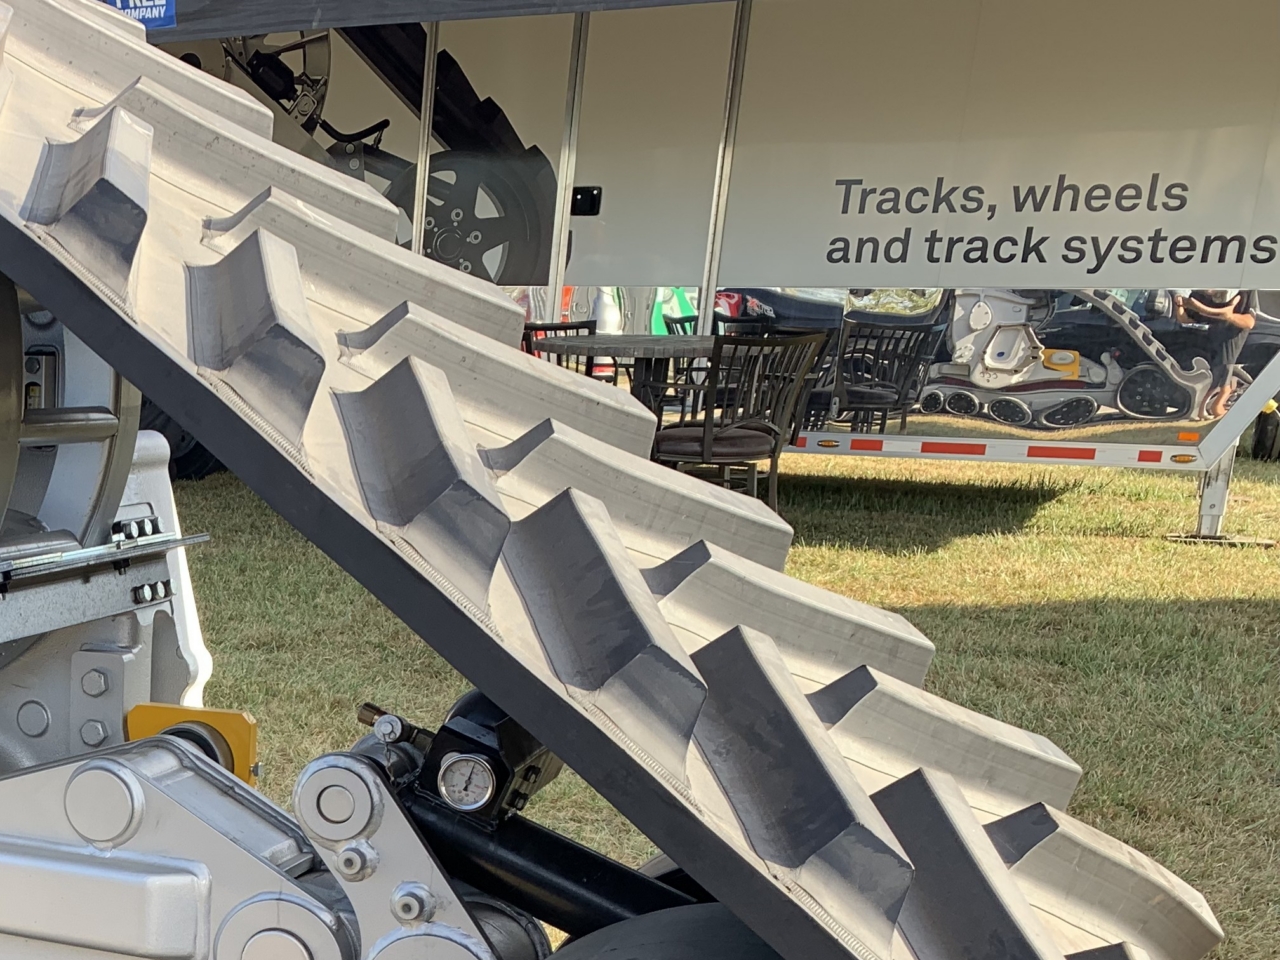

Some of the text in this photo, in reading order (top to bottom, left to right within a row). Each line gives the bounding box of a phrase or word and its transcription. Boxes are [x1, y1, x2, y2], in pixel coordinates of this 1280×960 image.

[835, 173, 1190, 220] Tracks, wheels
[826, 227, 1278, 275] and track systems
